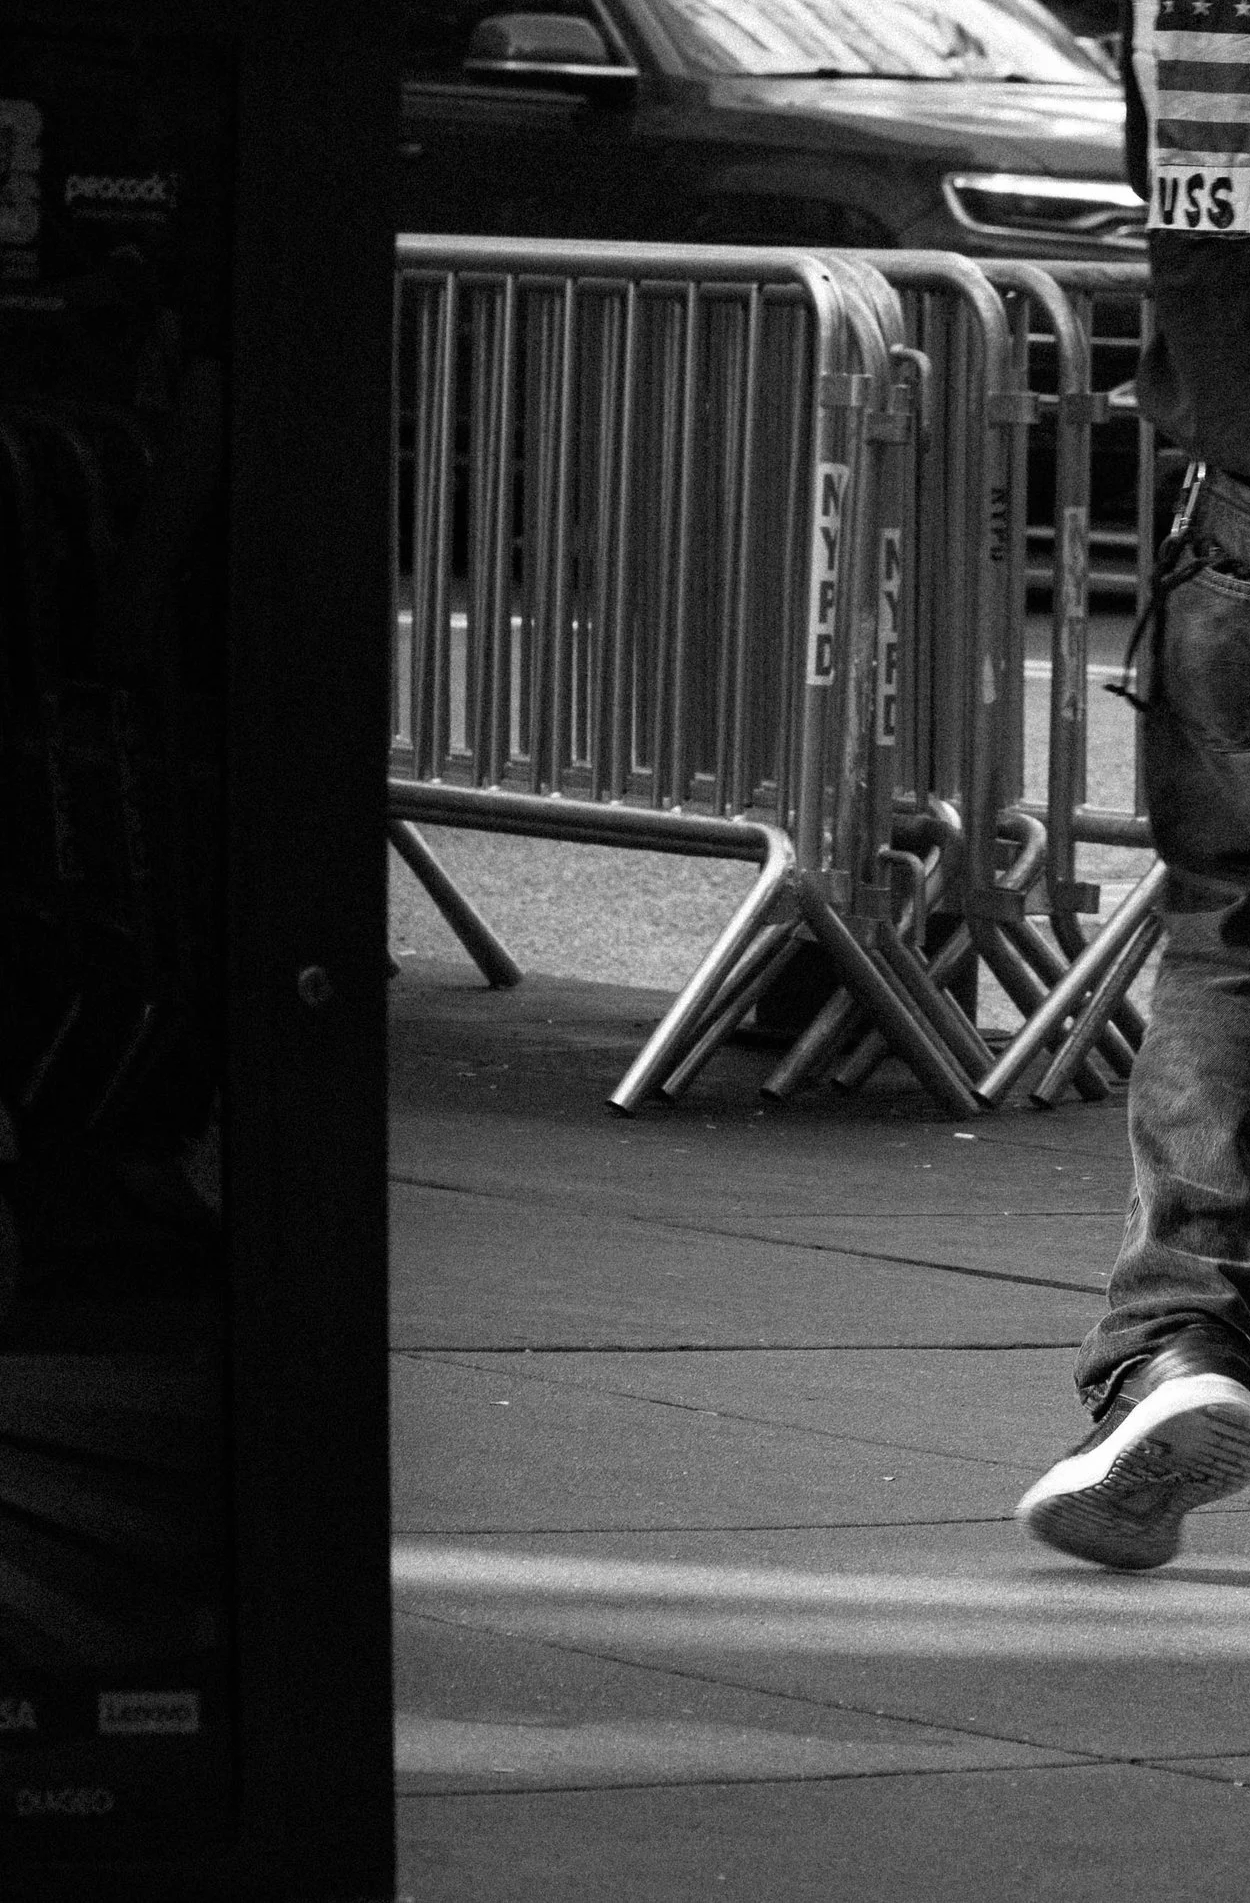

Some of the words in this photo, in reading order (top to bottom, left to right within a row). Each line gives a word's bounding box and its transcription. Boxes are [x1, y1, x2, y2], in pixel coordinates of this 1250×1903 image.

[1158, 172, 1235, 229] USS
[814, 471, 842, 678] NYPD
[104, 1700, 193, 1725] Lenovo
